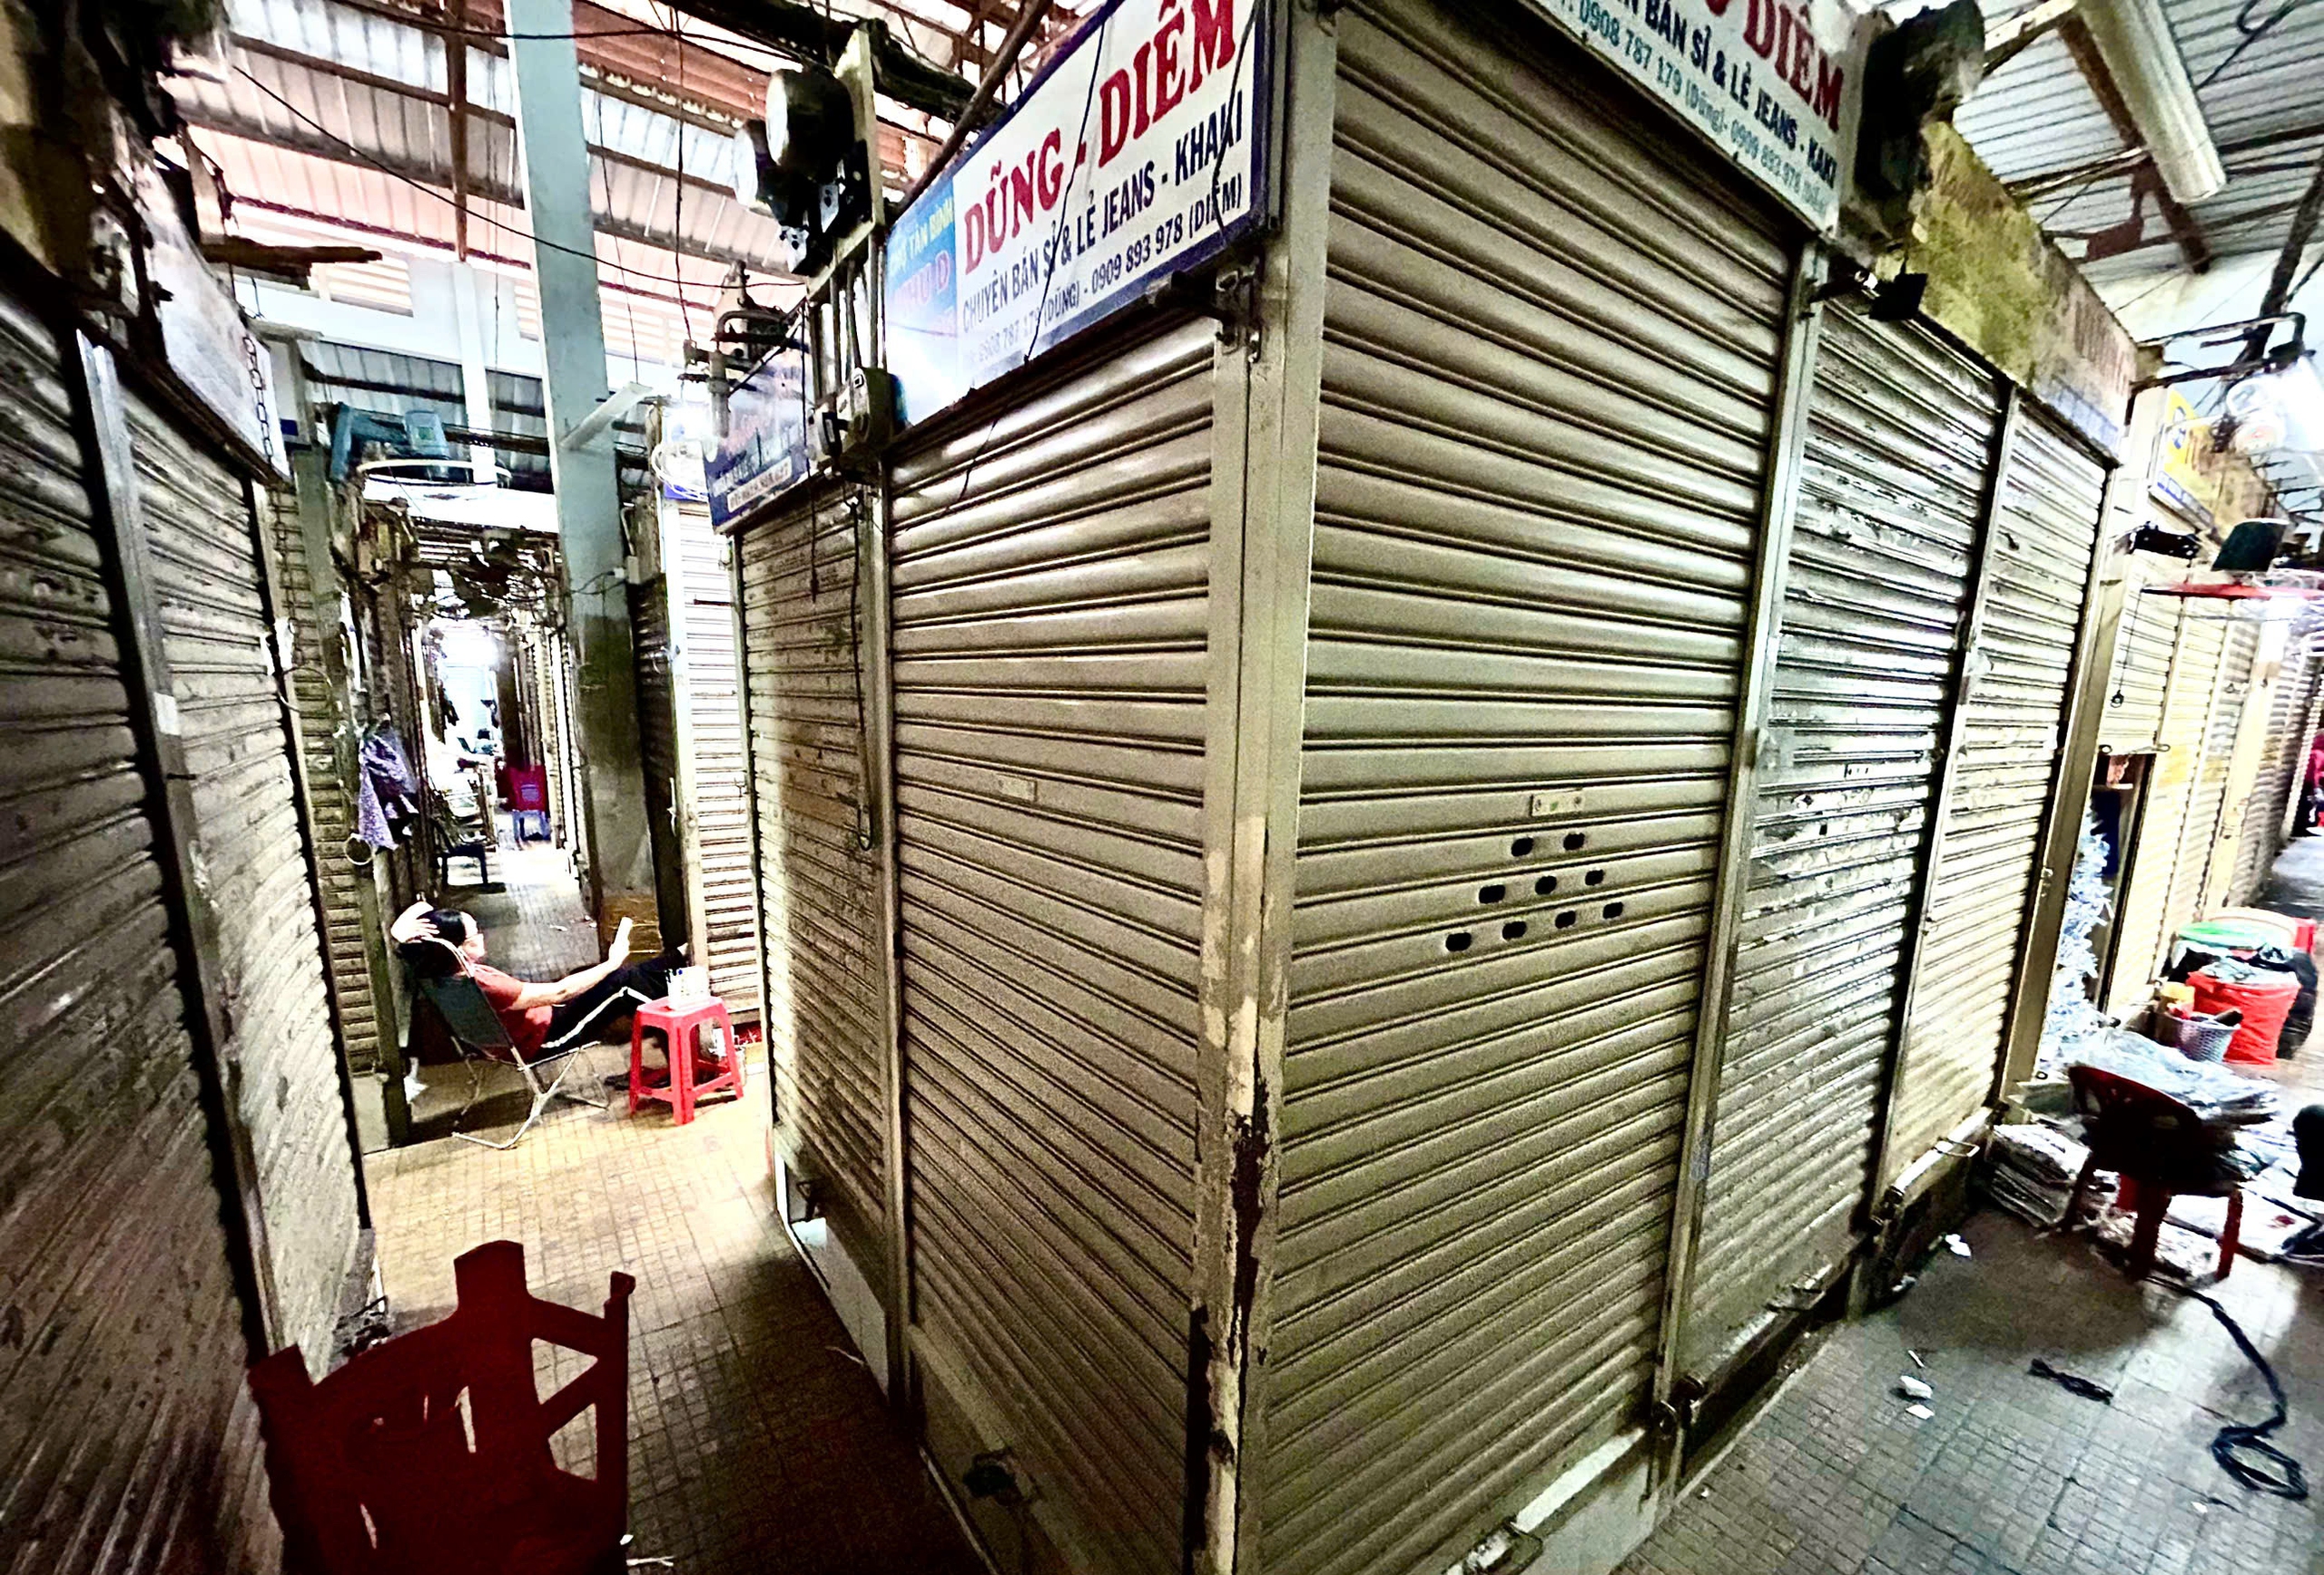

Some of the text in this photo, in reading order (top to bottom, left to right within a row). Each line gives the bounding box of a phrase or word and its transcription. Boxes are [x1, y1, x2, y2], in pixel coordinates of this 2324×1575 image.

[1625, 29, 1652, 70] 787
[1657, 56, 1681, 94] 179
[1712, 50, 1726, 89] &
[964, 127, 1064, 275] DŨNG
[1012, 246, 1039, 300] BÁN
[1061, 225, 1072, 266] &
[1078, 189, 1096, 256] LẺ
[1102, 161, 1155, 240] JEANS
[1176, 89, 1243, 186] KHAKI
[1091, 253, 1122, 294] 0909
[1126, 234, 1151, 273] 893
[1156, 212, 1183, 255] 978
